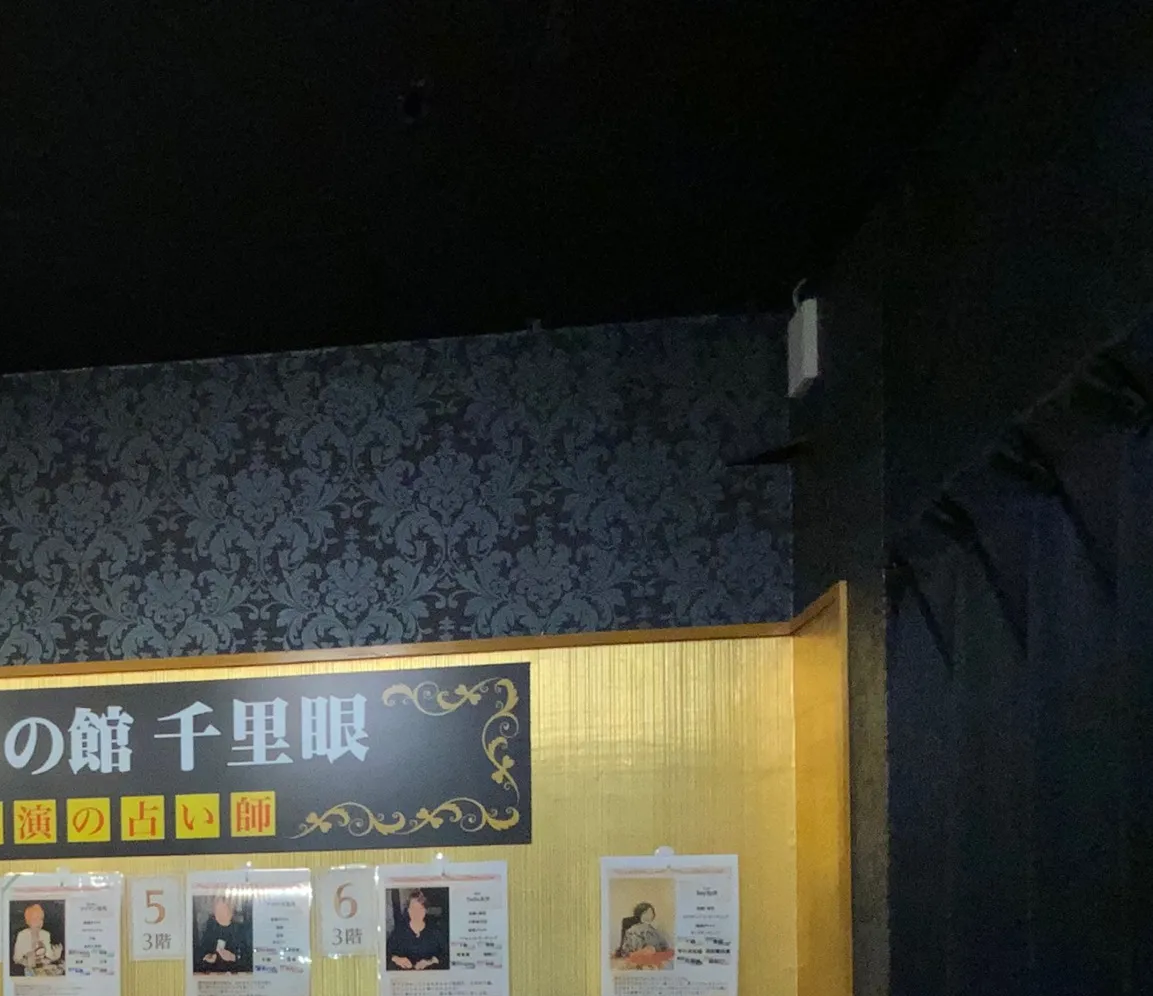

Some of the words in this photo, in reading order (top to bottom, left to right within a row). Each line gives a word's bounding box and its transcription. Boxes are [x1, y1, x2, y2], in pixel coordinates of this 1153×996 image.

[153, 694, 370, 772] 千里眼
[144, 889, 166, 925] 5
[335, 883, 358, 920] 6
[142, 932, 171, 951] 3階
[332, 927, 363, 946] 3階
